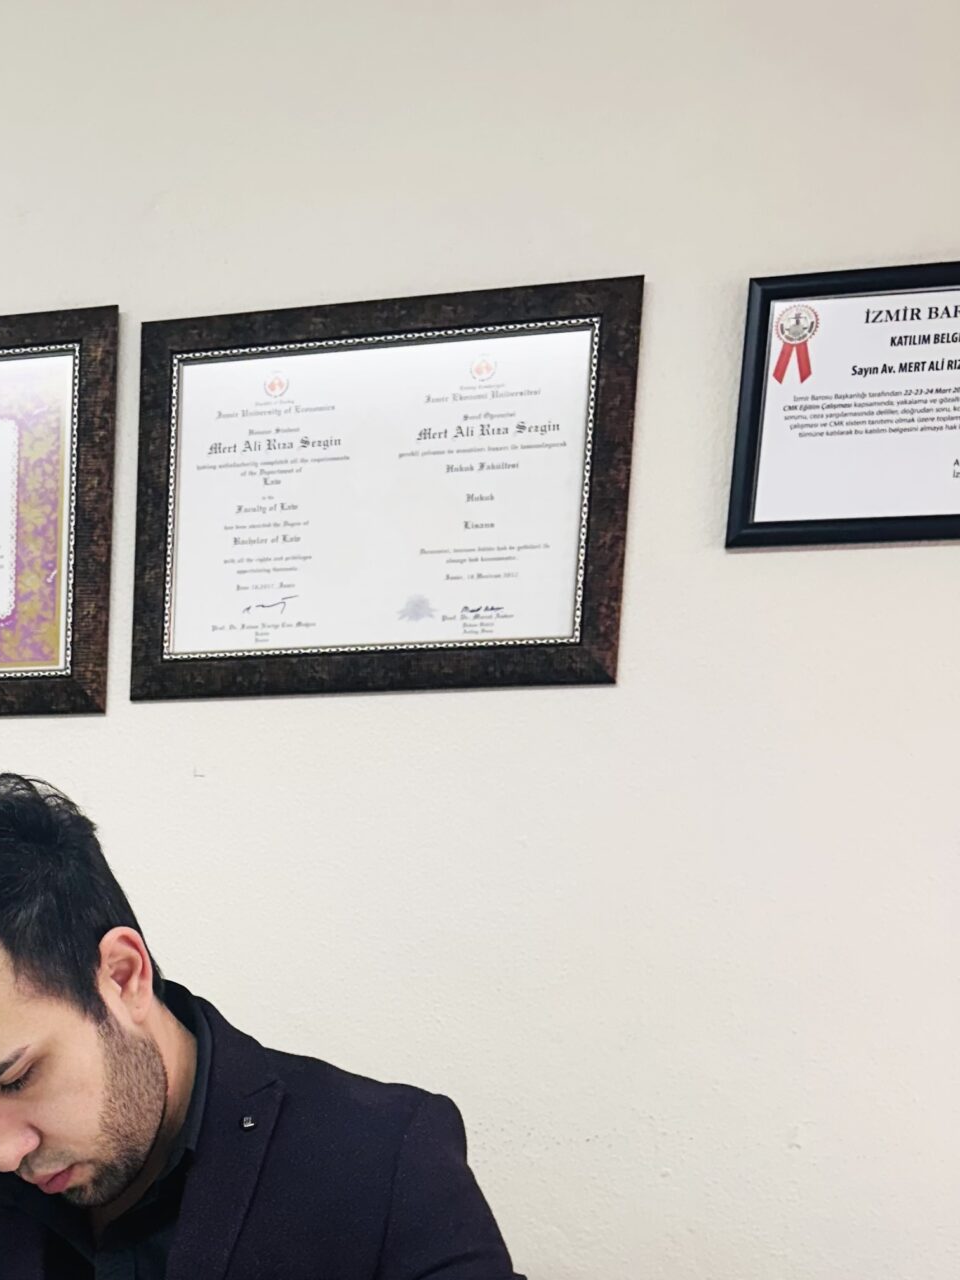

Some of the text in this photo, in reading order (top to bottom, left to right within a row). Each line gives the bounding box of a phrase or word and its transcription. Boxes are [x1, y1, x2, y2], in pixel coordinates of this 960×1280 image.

[864, 306, 922, 324] İZMİR
[890, 334, 931, 347] KATILIM
[851, 365, 879, 378] Sayın
[881, 363, 896, 374] Av.
[898, 361, 927, 373] MERT
[928, 357, 945, 371] ALİ
[868, 390, 902, 398] tarafından
[903, 388, 934, 396] 22-23-24
[782, 404, 798, 412] CMK
[821, 402, 853, 410] Çalışması
[900, 407, 934, 415] doğrudan
[416, 427, 448, 441] Mert
[453, 425, 474, 439] Ali
[515, 420, 560, 436] Sezgin
[207, 441, 237, 455] Mert
[241, 440, 261, 453] Ali
[299, 435, 342, 450] Sezgin
